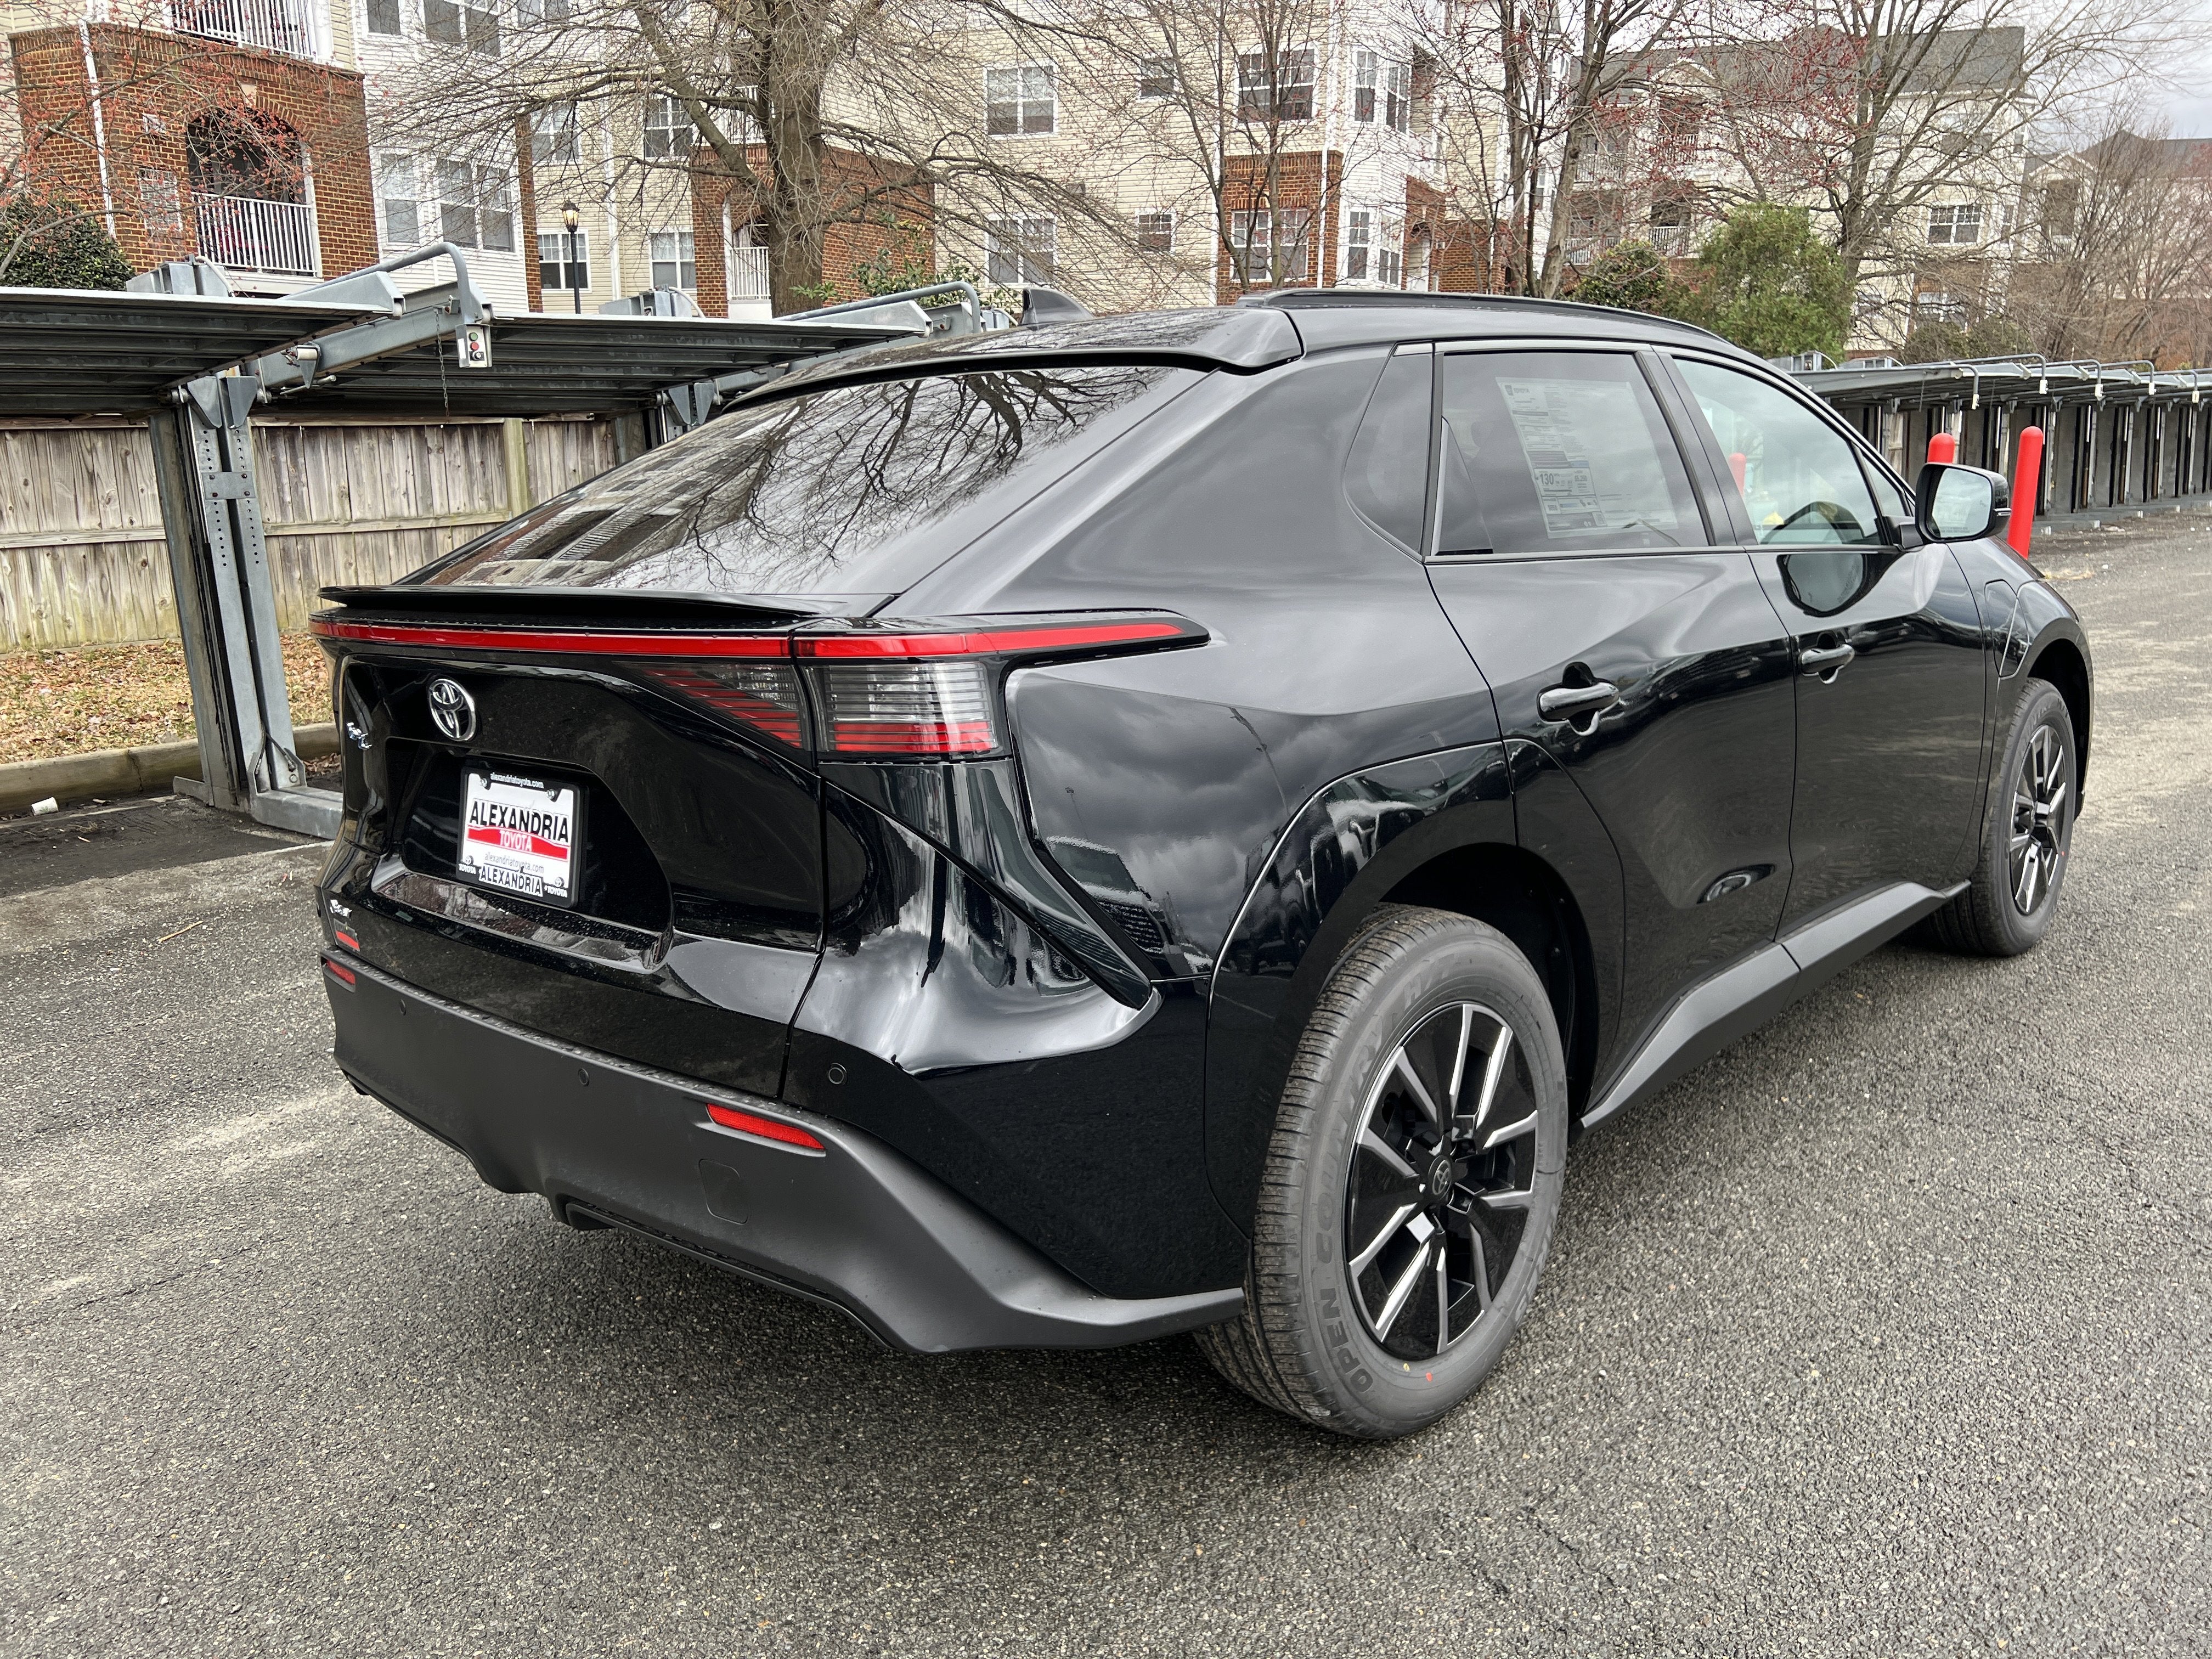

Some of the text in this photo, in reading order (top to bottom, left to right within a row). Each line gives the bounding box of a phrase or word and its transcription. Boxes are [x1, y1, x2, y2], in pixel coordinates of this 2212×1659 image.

[1539, 473, 1554, 485] 130
[490, 772, 544, 788] alexandriatoyota.com
[470, 800, 568, 843] ALEXANDRIA
[499, 831, 532, 851] TOYOTA
[484, 852, 544, 873] alexandriatoyota.com
[459, 864, 568, 898] TOYOTA ALEXANDRIA TOYOTA
[1320, 1288, 1374, 1393] OPEN
